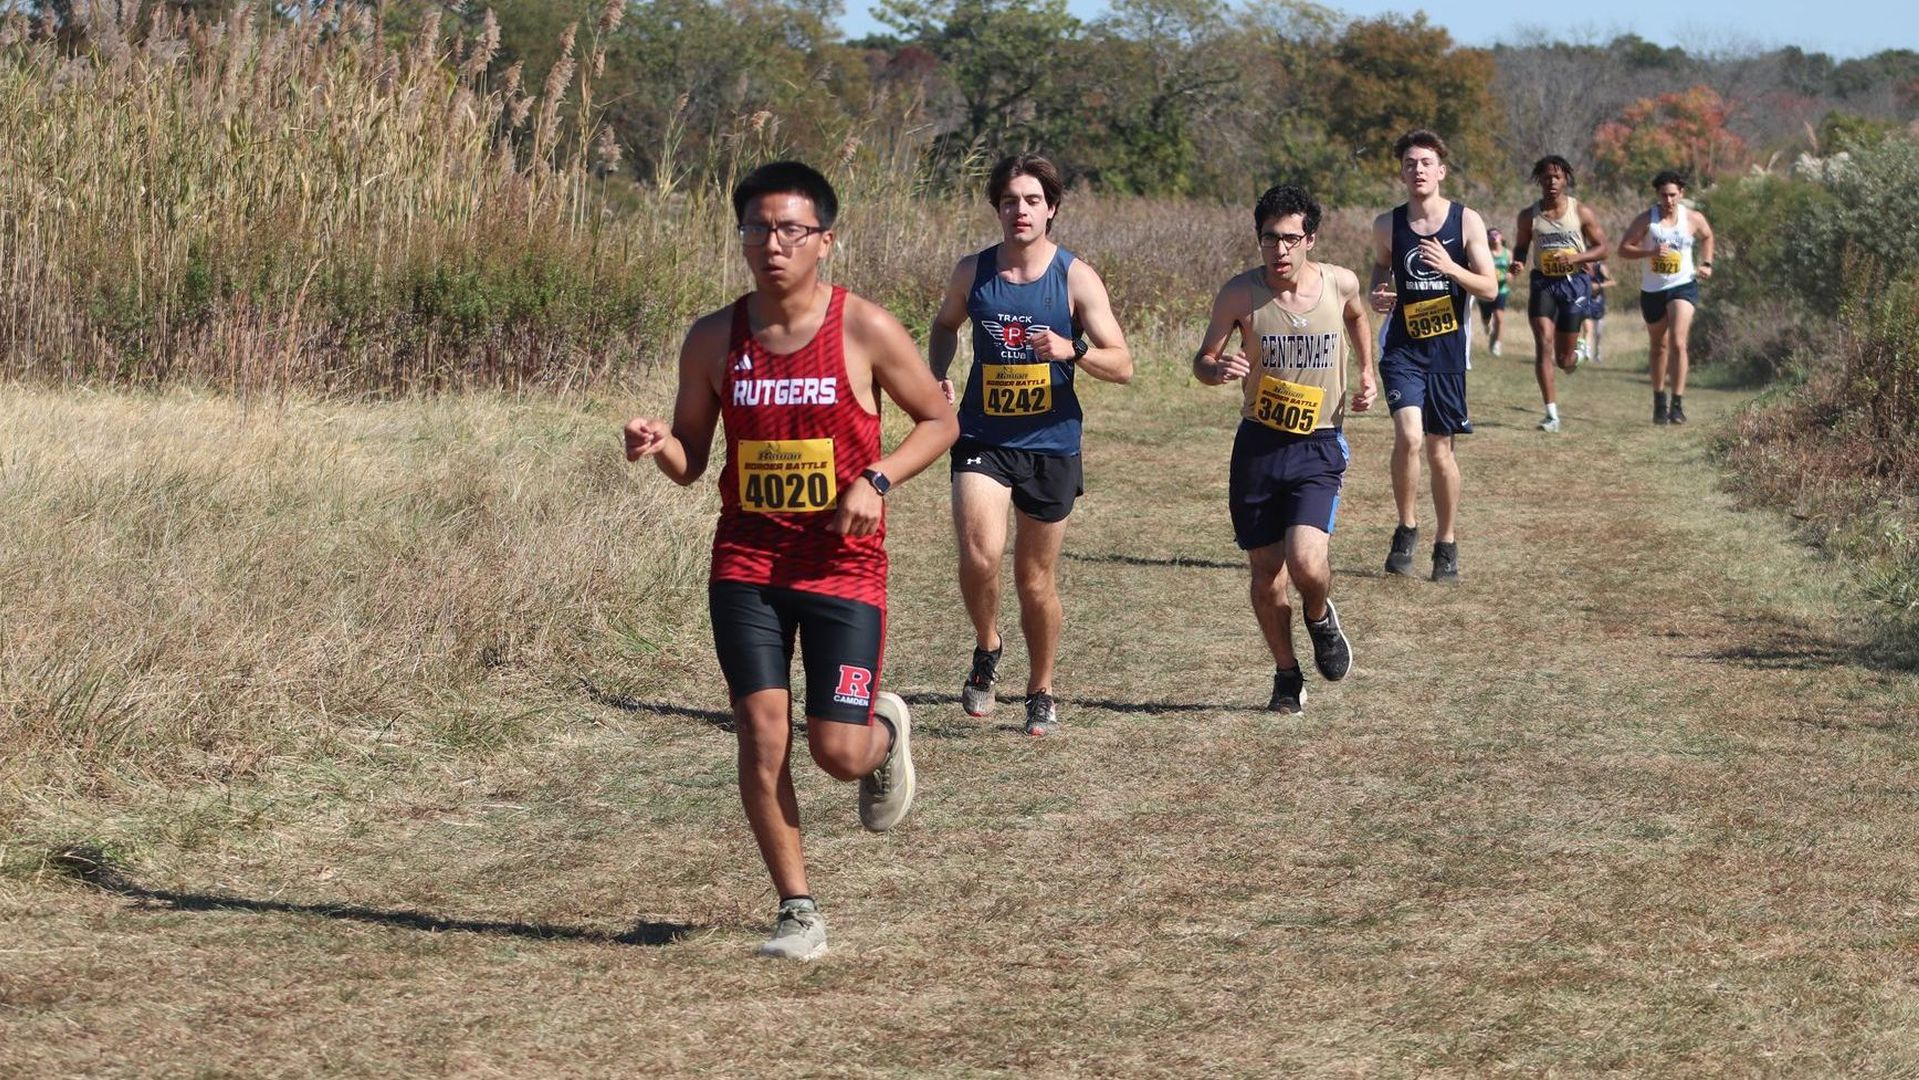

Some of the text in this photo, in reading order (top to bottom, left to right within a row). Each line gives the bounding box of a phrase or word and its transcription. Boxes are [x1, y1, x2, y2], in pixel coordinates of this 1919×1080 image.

[997, 313, 1033, 324] TRACK
[1408, 312, 1453, 337] 3939
[1008, 327, 1021, 341] P
[1000, 350, 1027, 360] CLUB
[1015, 378, 1046, 387] BATTLE
[733, 377, 837, 406] RUTGERS
[988, 387, 1046, 413] 4242
[1290, 398, 1318, 408] BATTLE
[1258, 397, 1315, 432] 3405
[744, 460, 828, 471] BORDER BATTLE
[745, 472, 829, 509] 4020
[835, 664, 872, 699] R
[833, 694, 870, 707] CAMDEN
